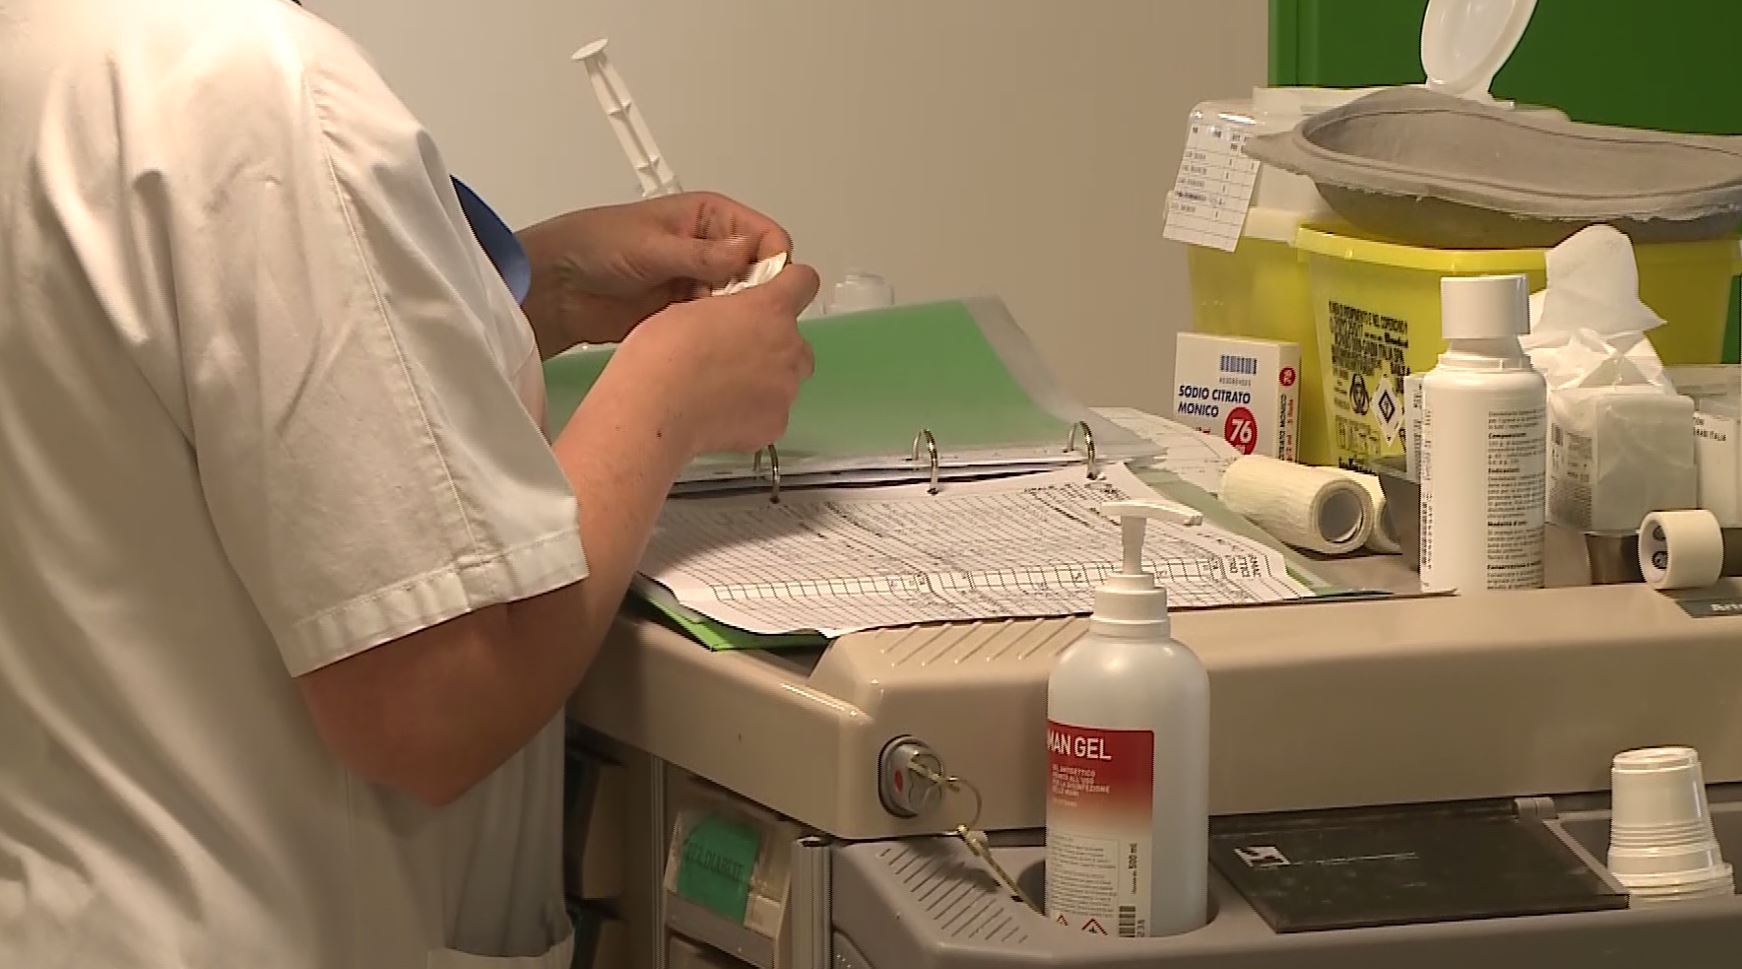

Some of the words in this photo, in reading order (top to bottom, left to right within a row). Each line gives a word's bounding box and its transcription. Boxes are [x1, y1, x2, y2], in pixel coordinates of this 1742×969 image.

[1178, 385, 1210, 401] SODIO
[1212, 389, 1251, 405] CITRATO
[1177, 402, 1219, 418] MONICO
[1230, 418, 1253, 444] 76
[1074, 736, 1112, 760] GEL
[1128, 855, 1138, 869] 500
